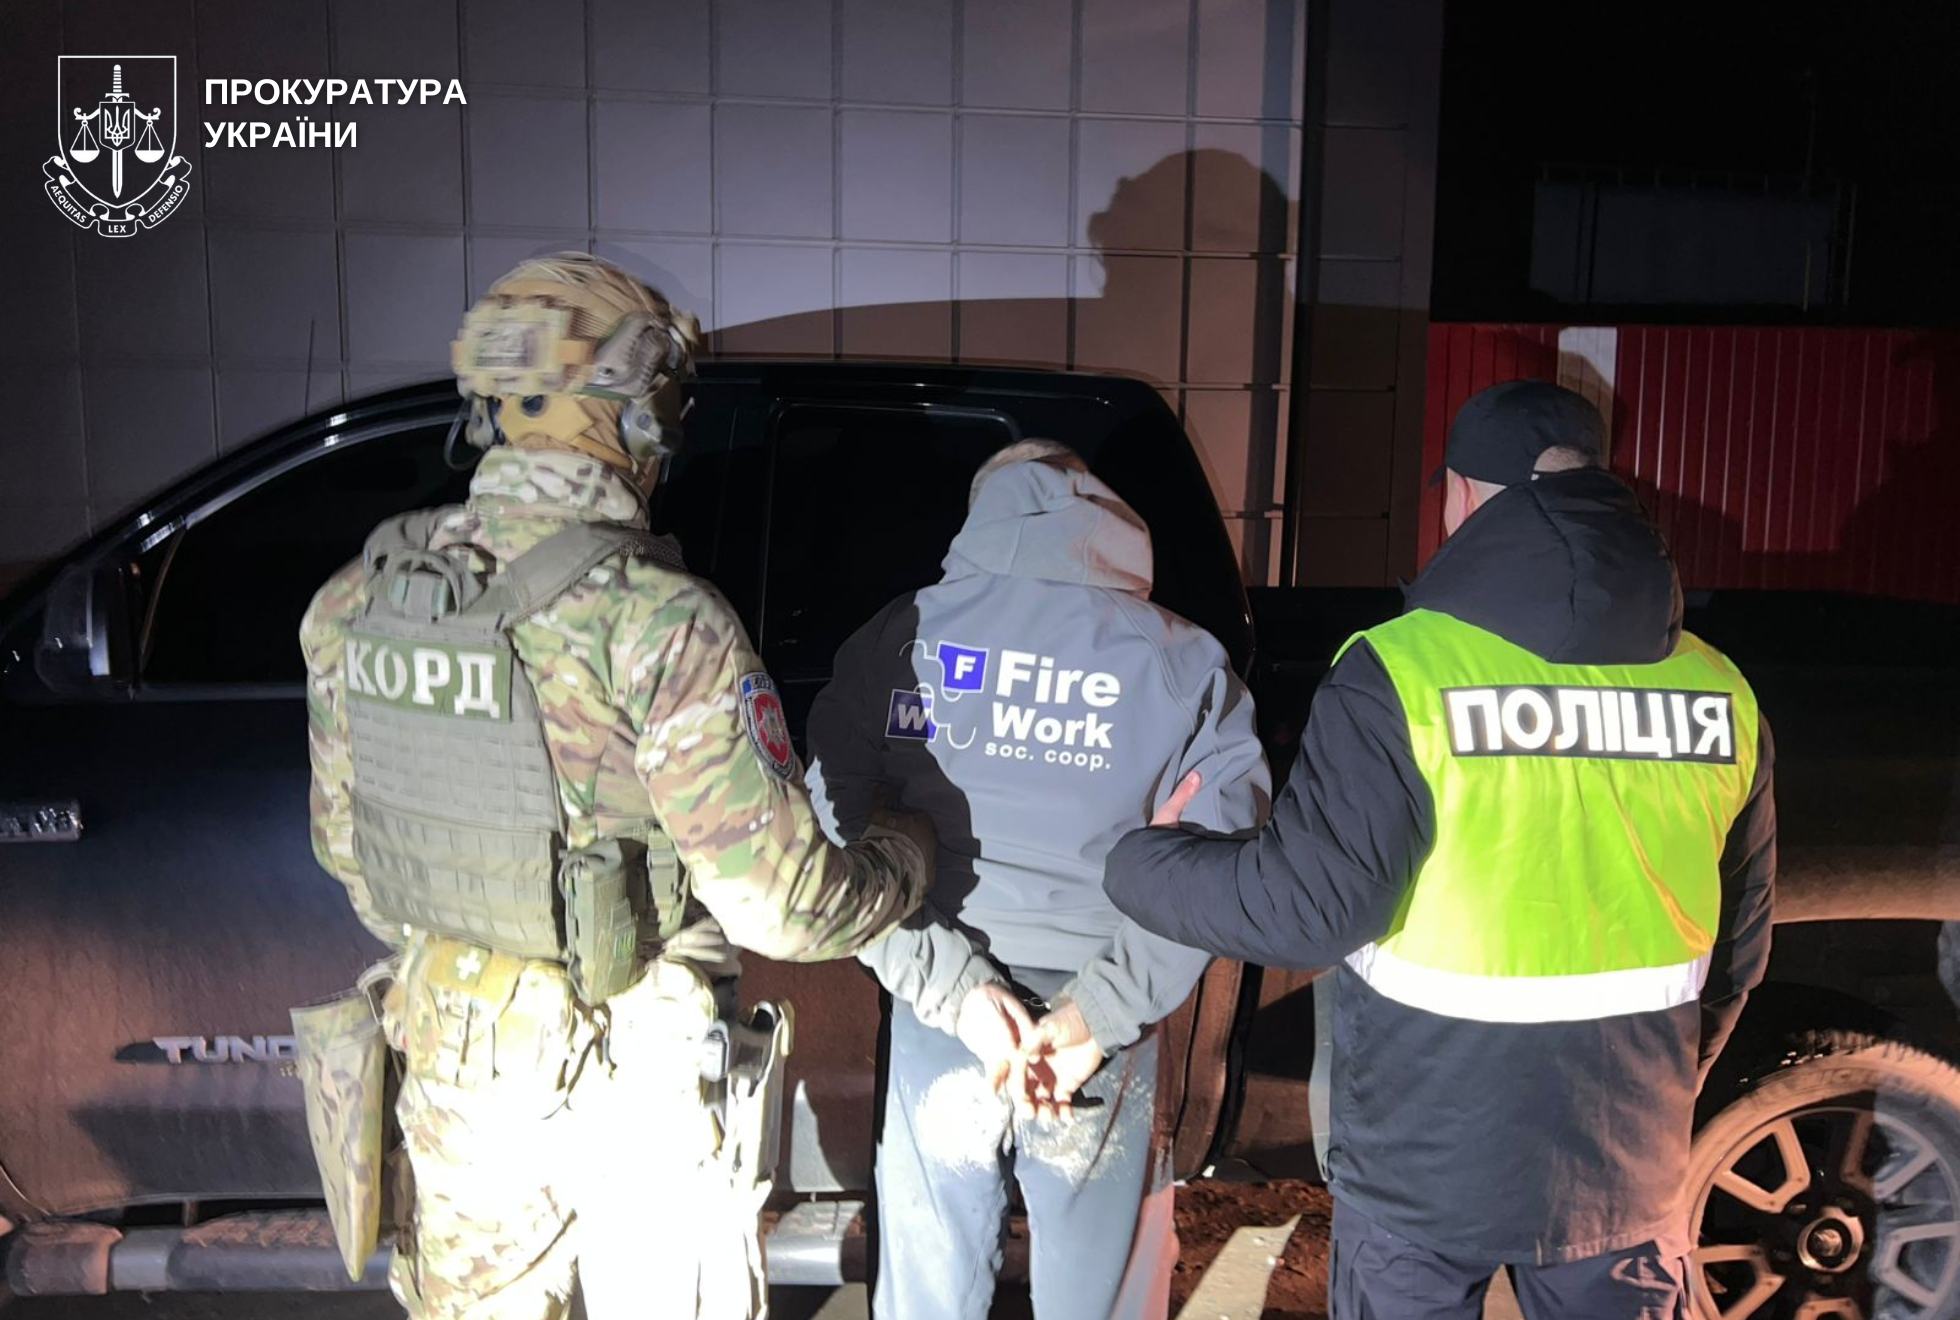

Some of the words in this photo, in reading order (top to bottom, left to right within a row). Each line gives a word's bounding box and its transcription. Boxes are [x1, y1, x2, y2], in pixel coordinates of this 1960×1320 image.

[346, 638, 500, 719] КОРД
[954, 654, 977, 680] F
[996, 650, 1121, 708] Fire
[897, 703, 931, 731] W
[992, 702, 1114, 749] Work
[1447, 688, 1731, 758] ПОЛІЦІЯ
[985, 742, 1034, 761] soc.
[1044, 749, 1111, 771] coop.
[152, 1035, 295, 1064] TUND
